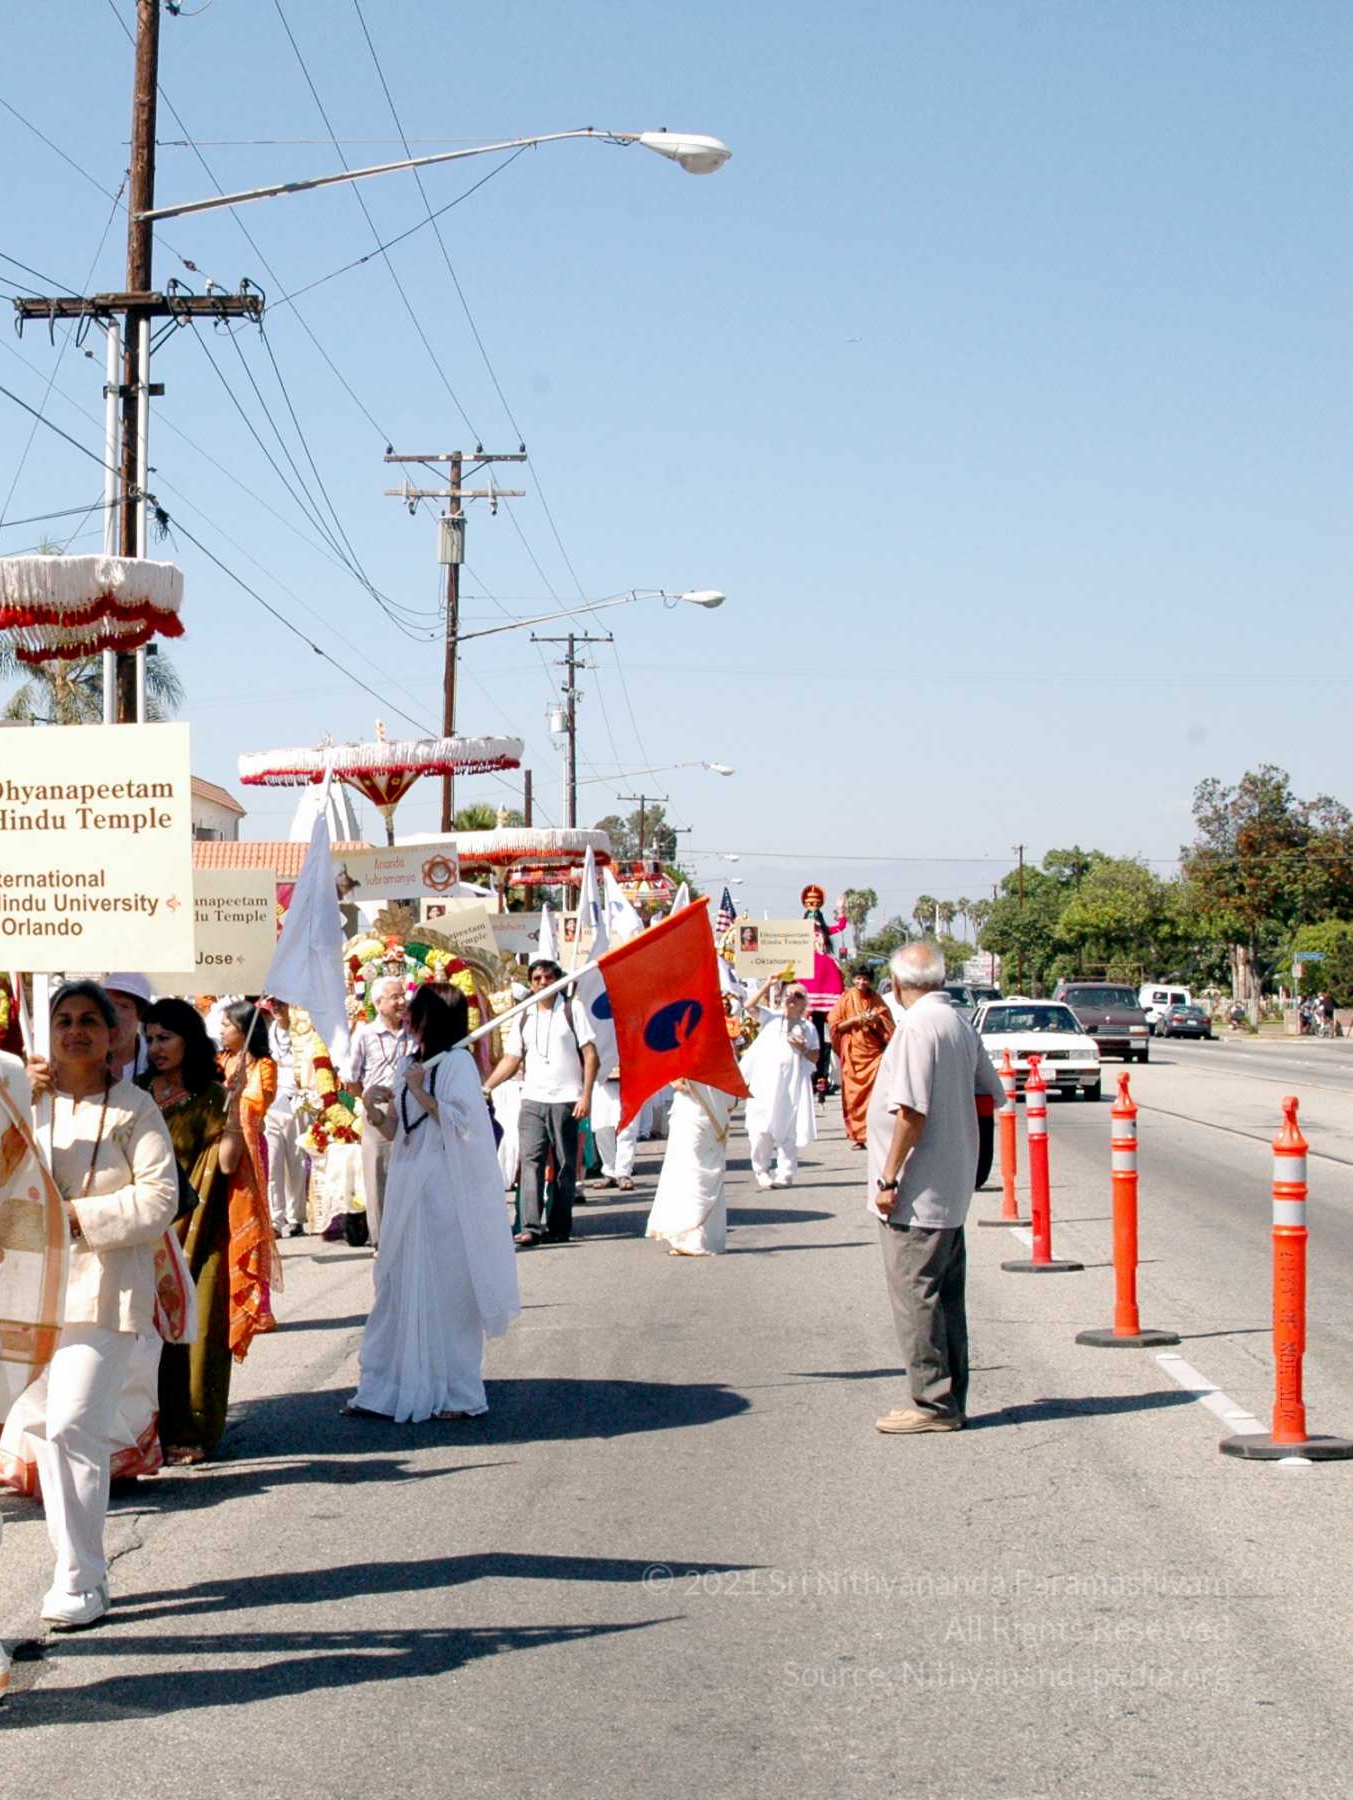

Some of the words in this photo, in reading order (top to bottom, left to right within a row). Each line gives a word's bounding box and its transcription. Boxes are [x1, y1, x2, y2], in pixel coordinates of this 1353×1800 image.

[75, 806, 172, 834] Temple
[54, 894, 159, 916] University
[1, 917, 83, 936] Orlando
[214, 910, 267, 924] Temple
[195, 951, 233, 965] Jose
